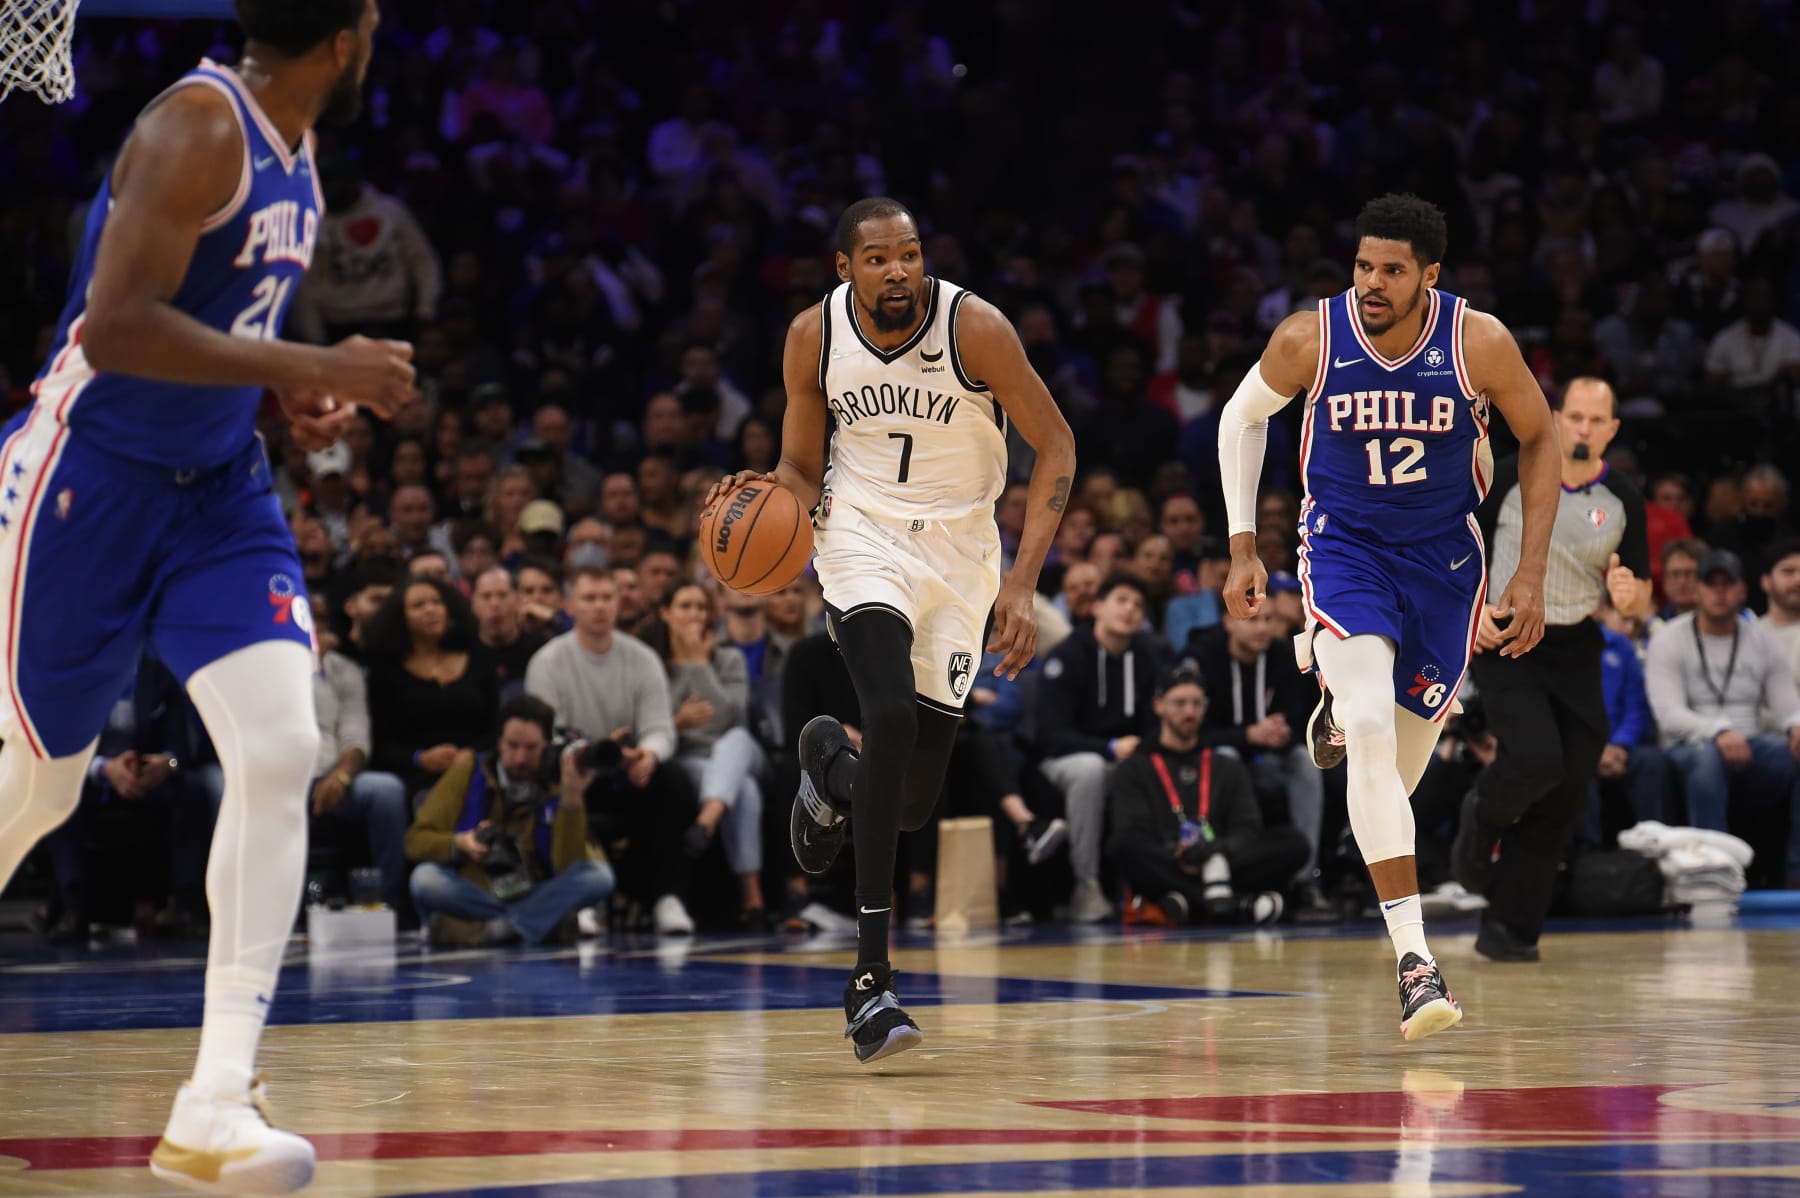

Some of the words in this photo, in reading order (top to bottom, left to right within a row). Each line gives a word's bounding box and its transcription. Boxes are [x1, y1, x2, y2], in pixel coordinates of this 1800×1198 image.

[230, 275, 291, 340] 21
[921, 366, 945, 374] Webull
[830, 383, 960, 425] BROOKLYN
[1326, 390, 1455, 433] PHILA
[888, 432, 913, 483] 7
[1365, 437, 1428, 486] 12
[716, 487, 763, 553] Wilson
